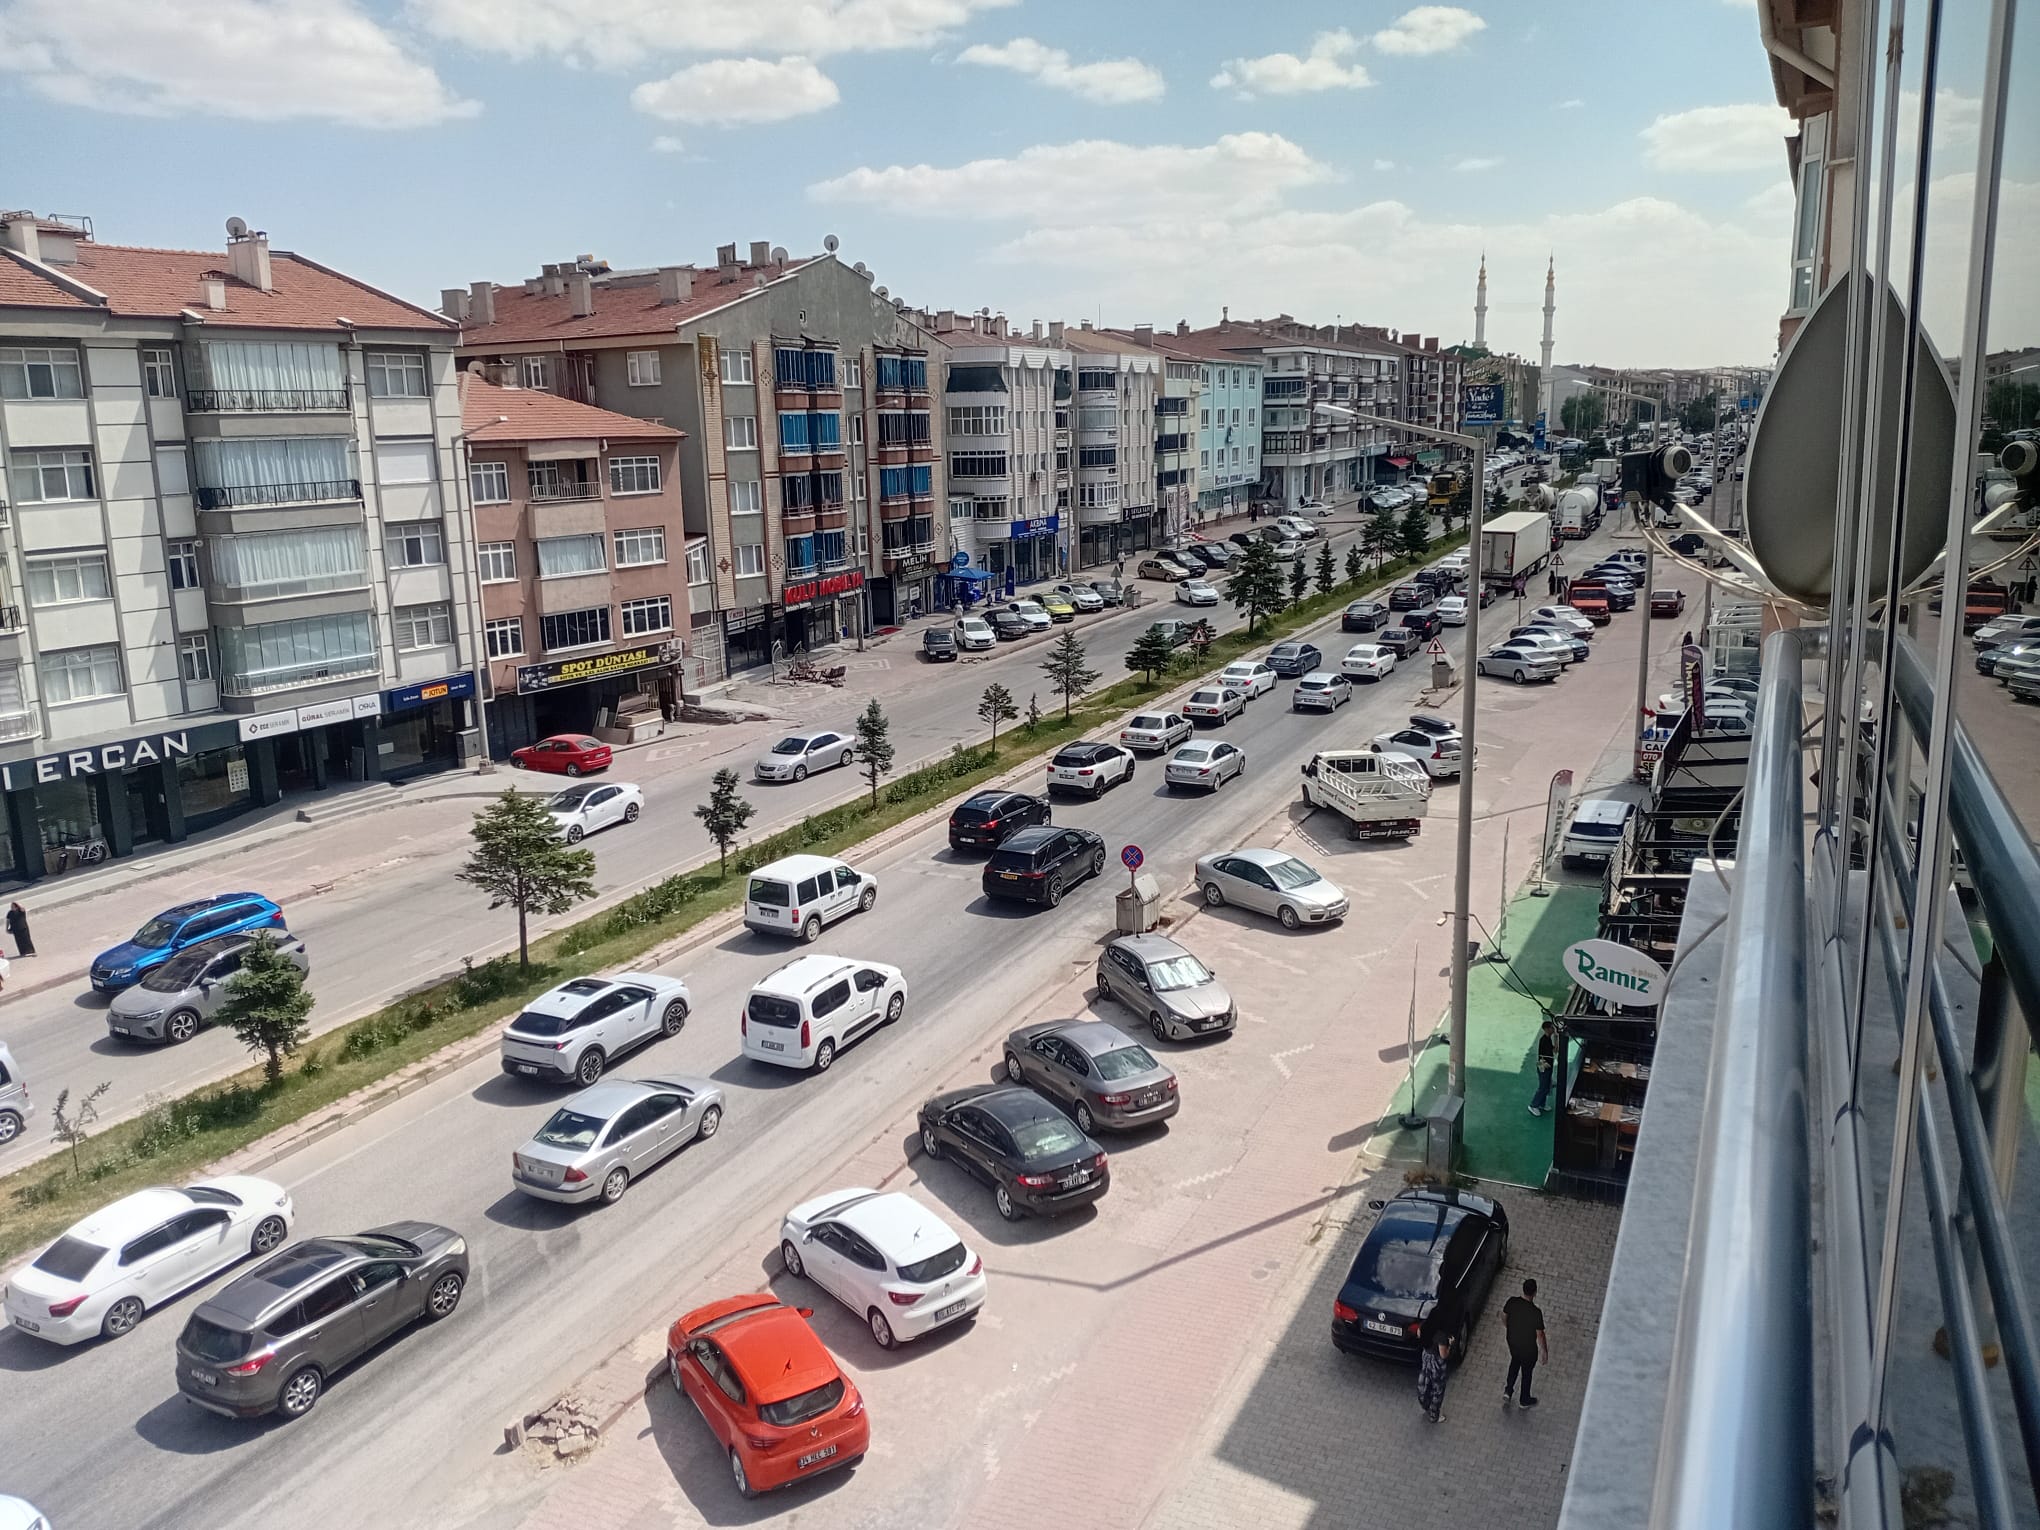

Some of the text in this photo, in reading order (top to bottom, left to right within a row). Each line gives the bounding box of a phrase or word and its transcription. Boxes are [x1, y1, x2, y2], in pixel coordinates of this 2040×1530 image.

[784, 582, 817, 604] KULU
[561, 649, 648, 674] SPOT DÜNYASI
[36, 732, 189, 784] ERCAN
